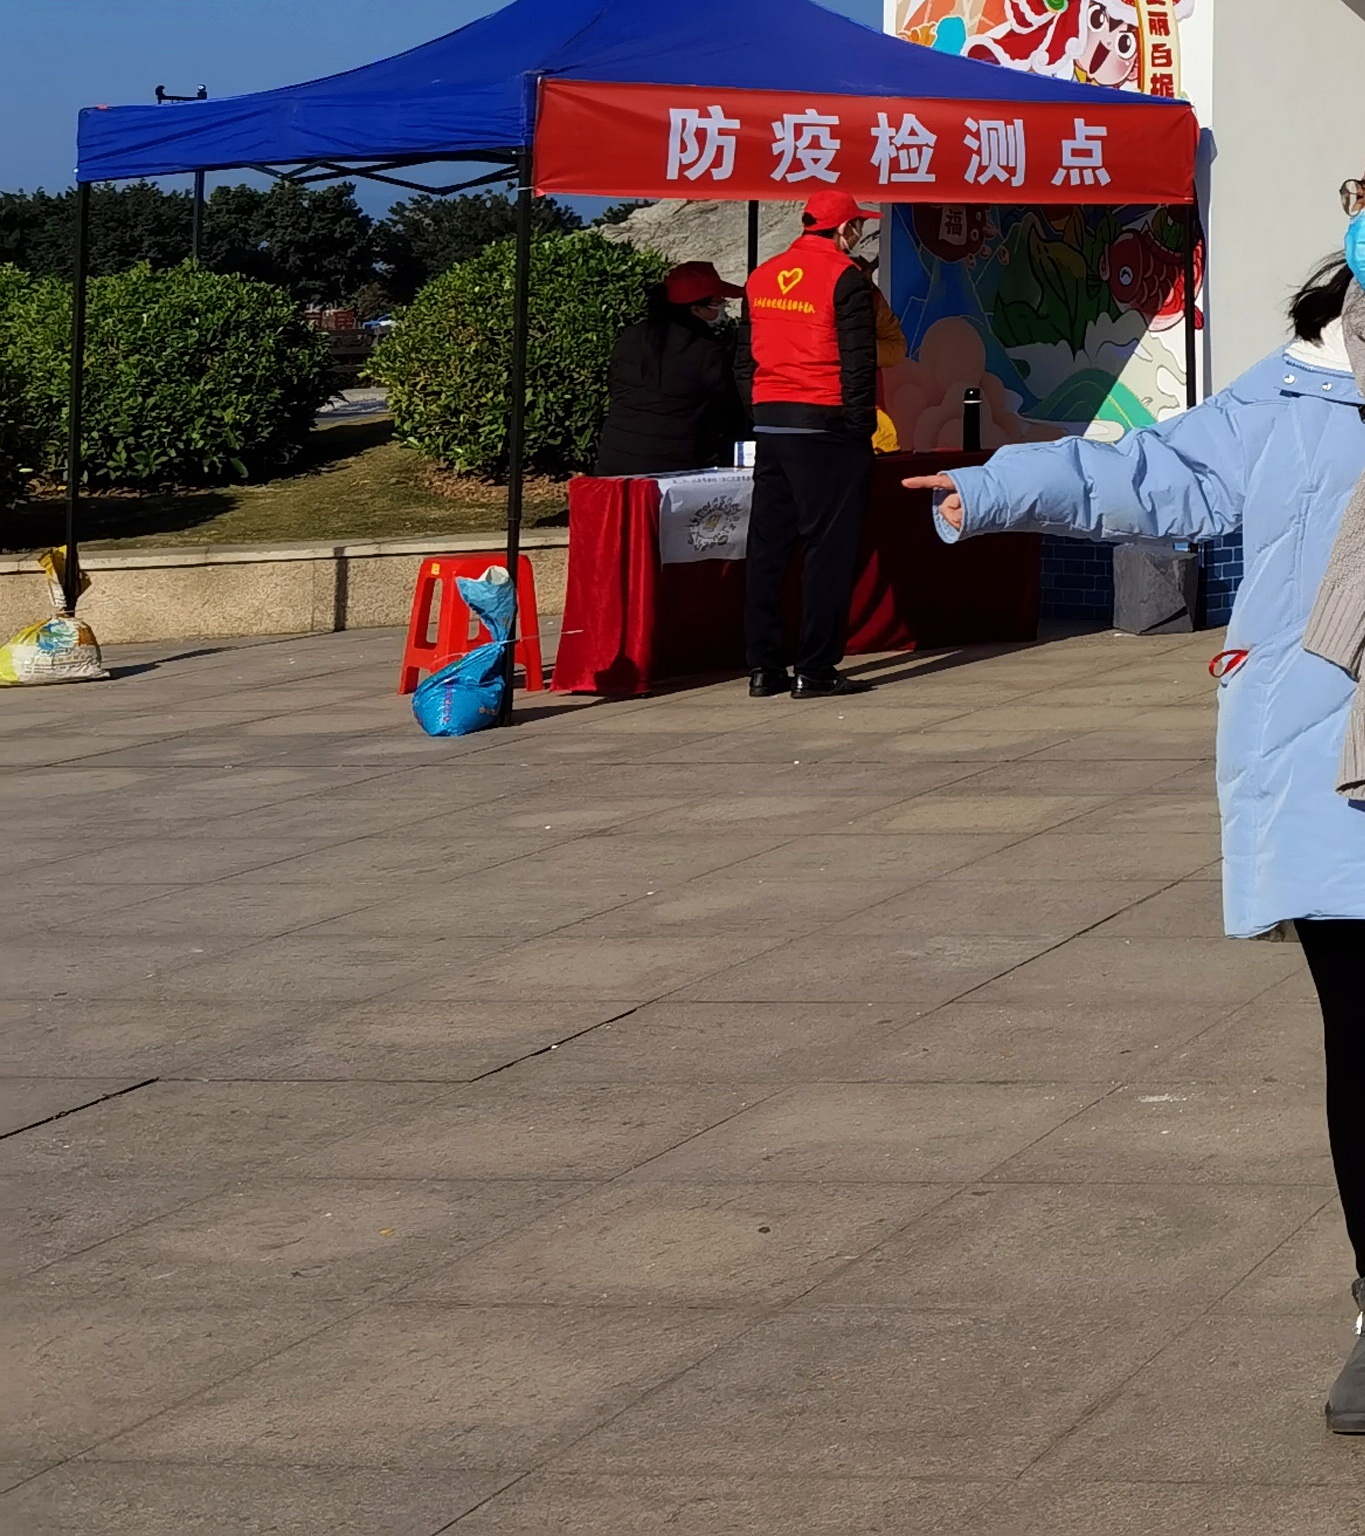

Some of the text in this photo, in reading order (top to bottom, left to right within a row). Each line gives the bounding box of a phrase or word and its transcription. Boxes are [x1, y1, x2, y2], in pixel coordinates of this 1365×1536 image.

[665, 105, 1112, 187] 防疫检测点
